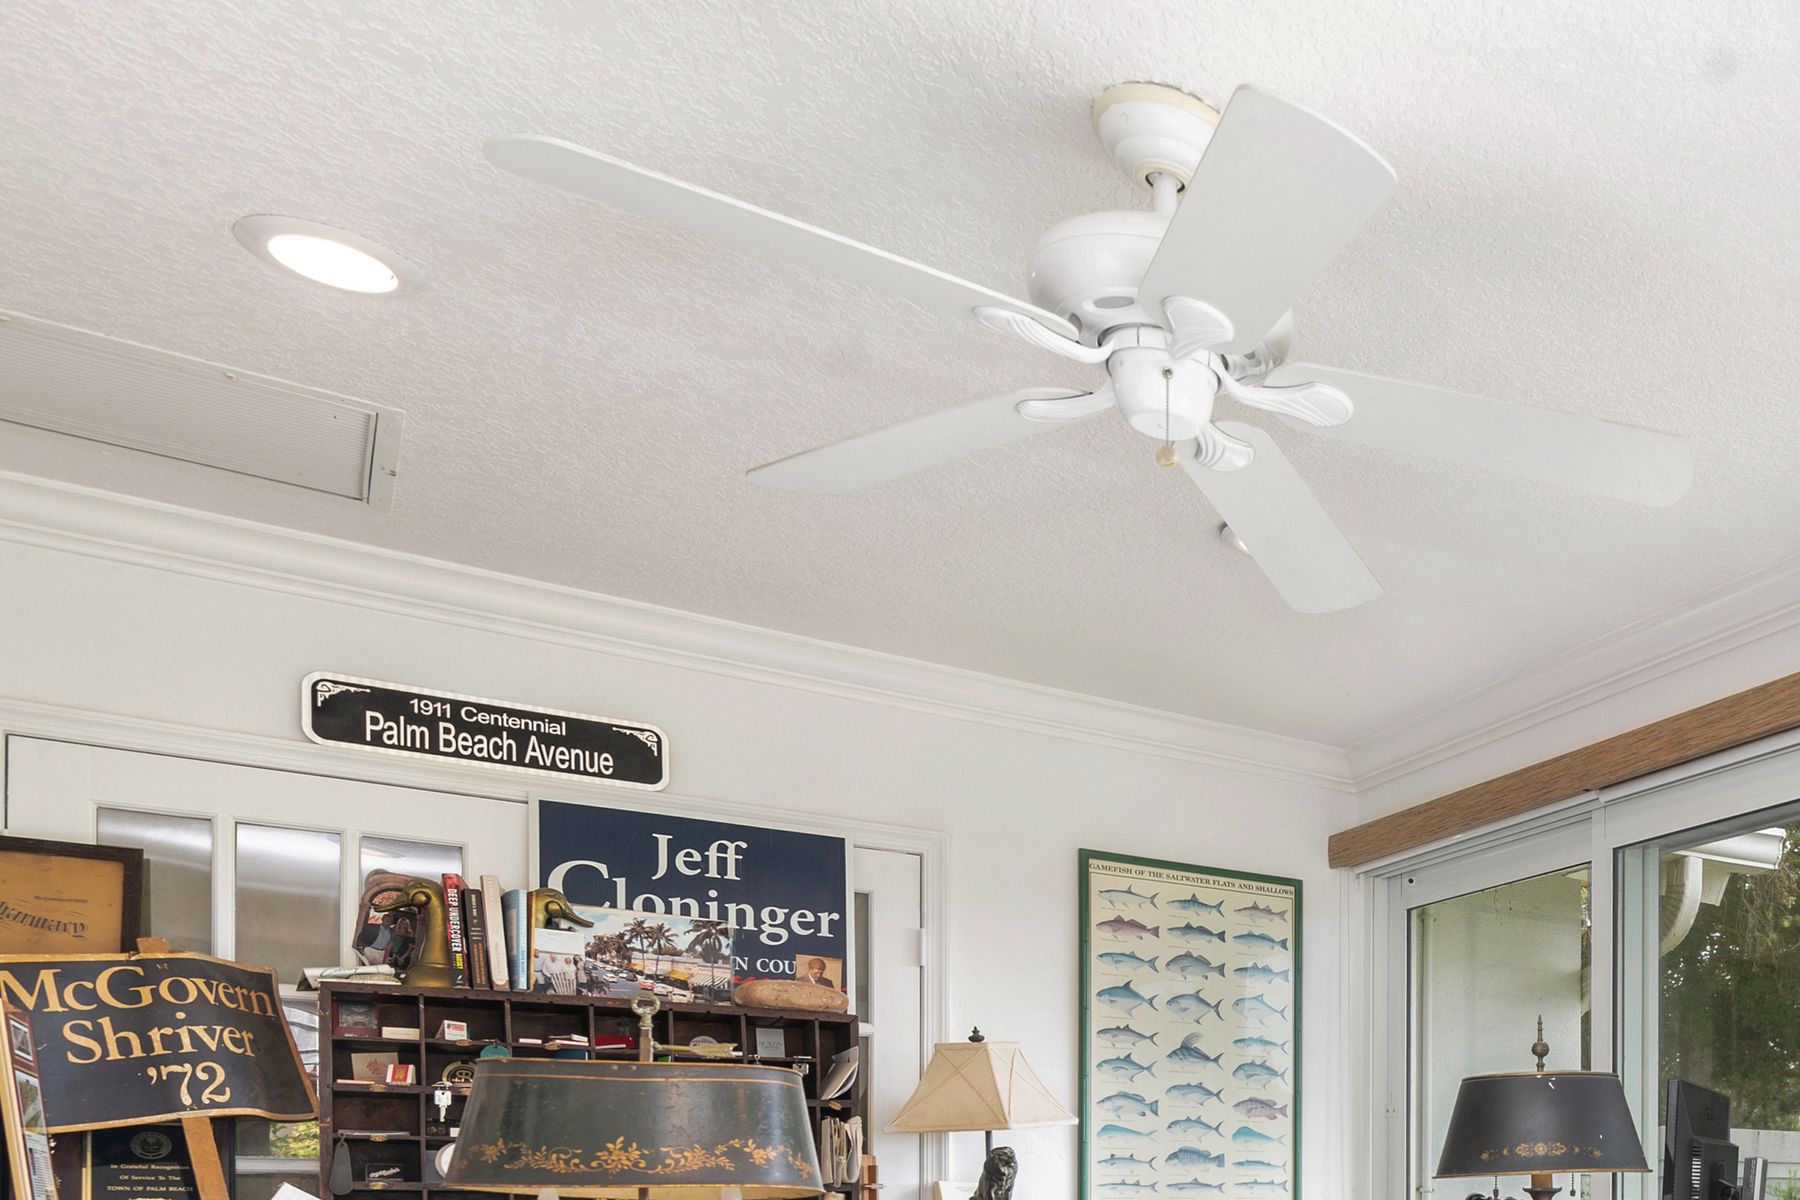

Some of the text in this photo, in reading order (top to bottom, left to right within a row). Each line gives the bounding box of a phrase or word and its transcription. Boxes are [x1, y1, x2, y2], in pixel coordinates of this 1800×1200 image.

[409, 698, 566, 736] 1911 Centennial
[364, 710, 614, 775] Palm Beach Avenue
[651, 833, 748, 881] Jeff
[1089, 862, 1294, 896] GAMEFISH OF THE SALTWATER FLATS AND SHALLOWS
[447, 888, 458, 906] DEEP
[547, 859, 840, 946] Cloninger
[449, 907, 462, 952] UNDERCOVER
[756, 957, 796, 975] COU
[0, 965, 277, 1017] McGovern
[62, 1011, 256, 1064] Shriver
